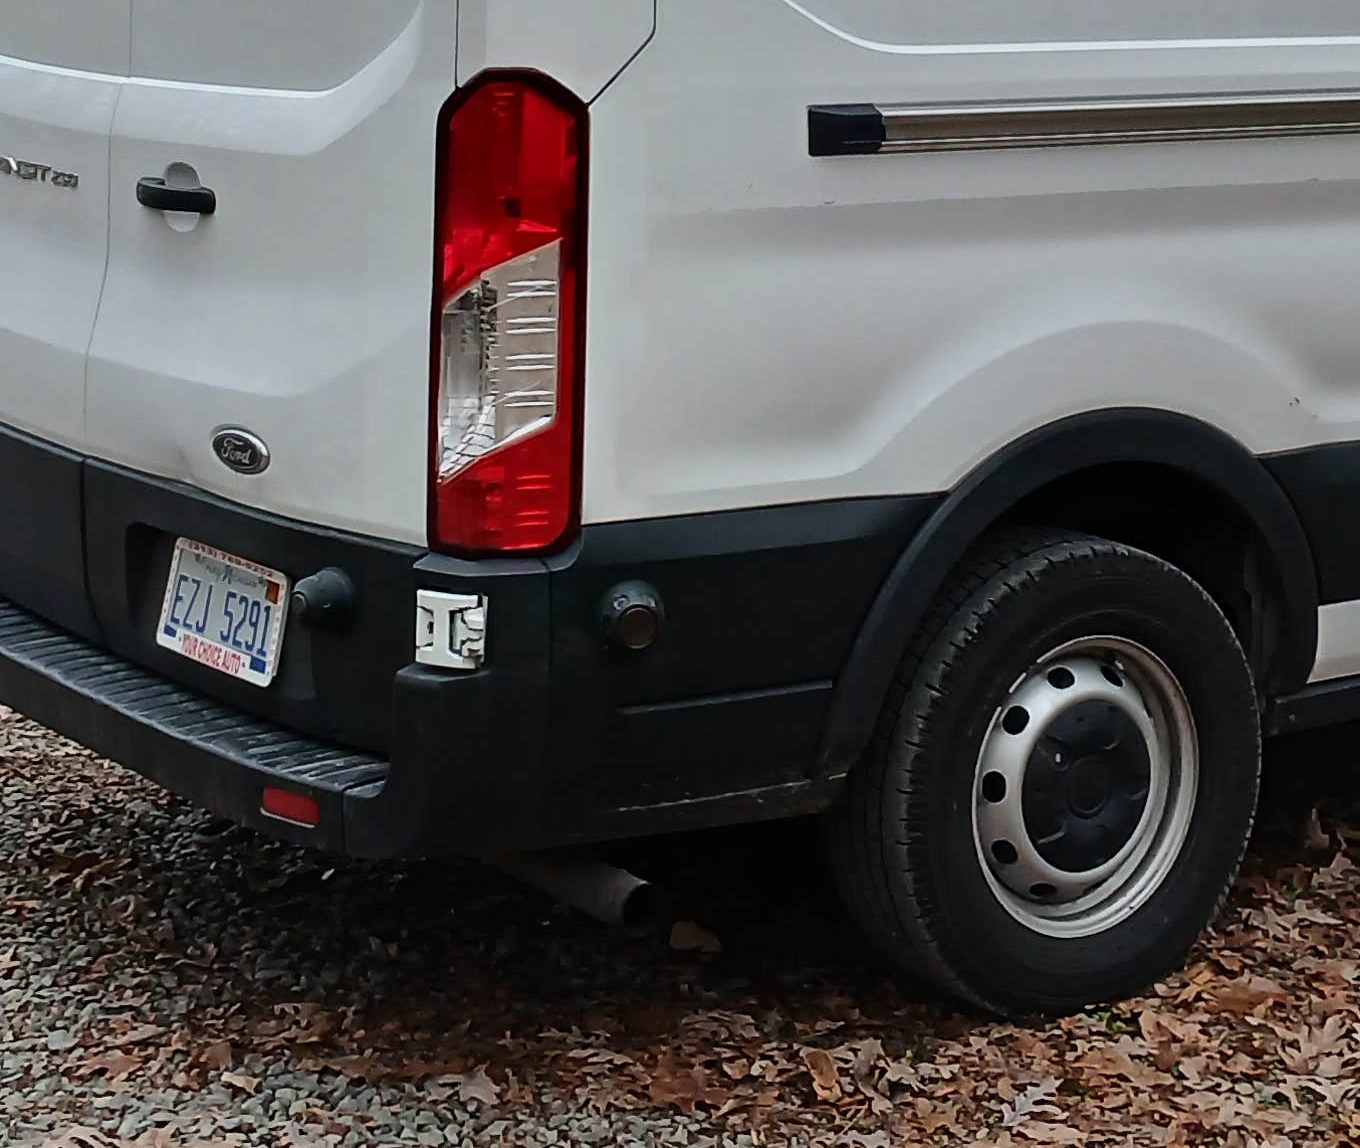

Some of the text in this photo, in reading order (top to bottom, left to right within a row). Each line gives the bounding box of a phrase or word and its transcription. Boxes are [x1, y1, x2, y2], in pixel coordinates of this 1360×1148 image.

[170, 573, 213, 634] EZJ
[220, 590, 272, 658] 5291
[198, 641, 223, 668] CHOICE
[221, 649, 242, 675] AUTO
